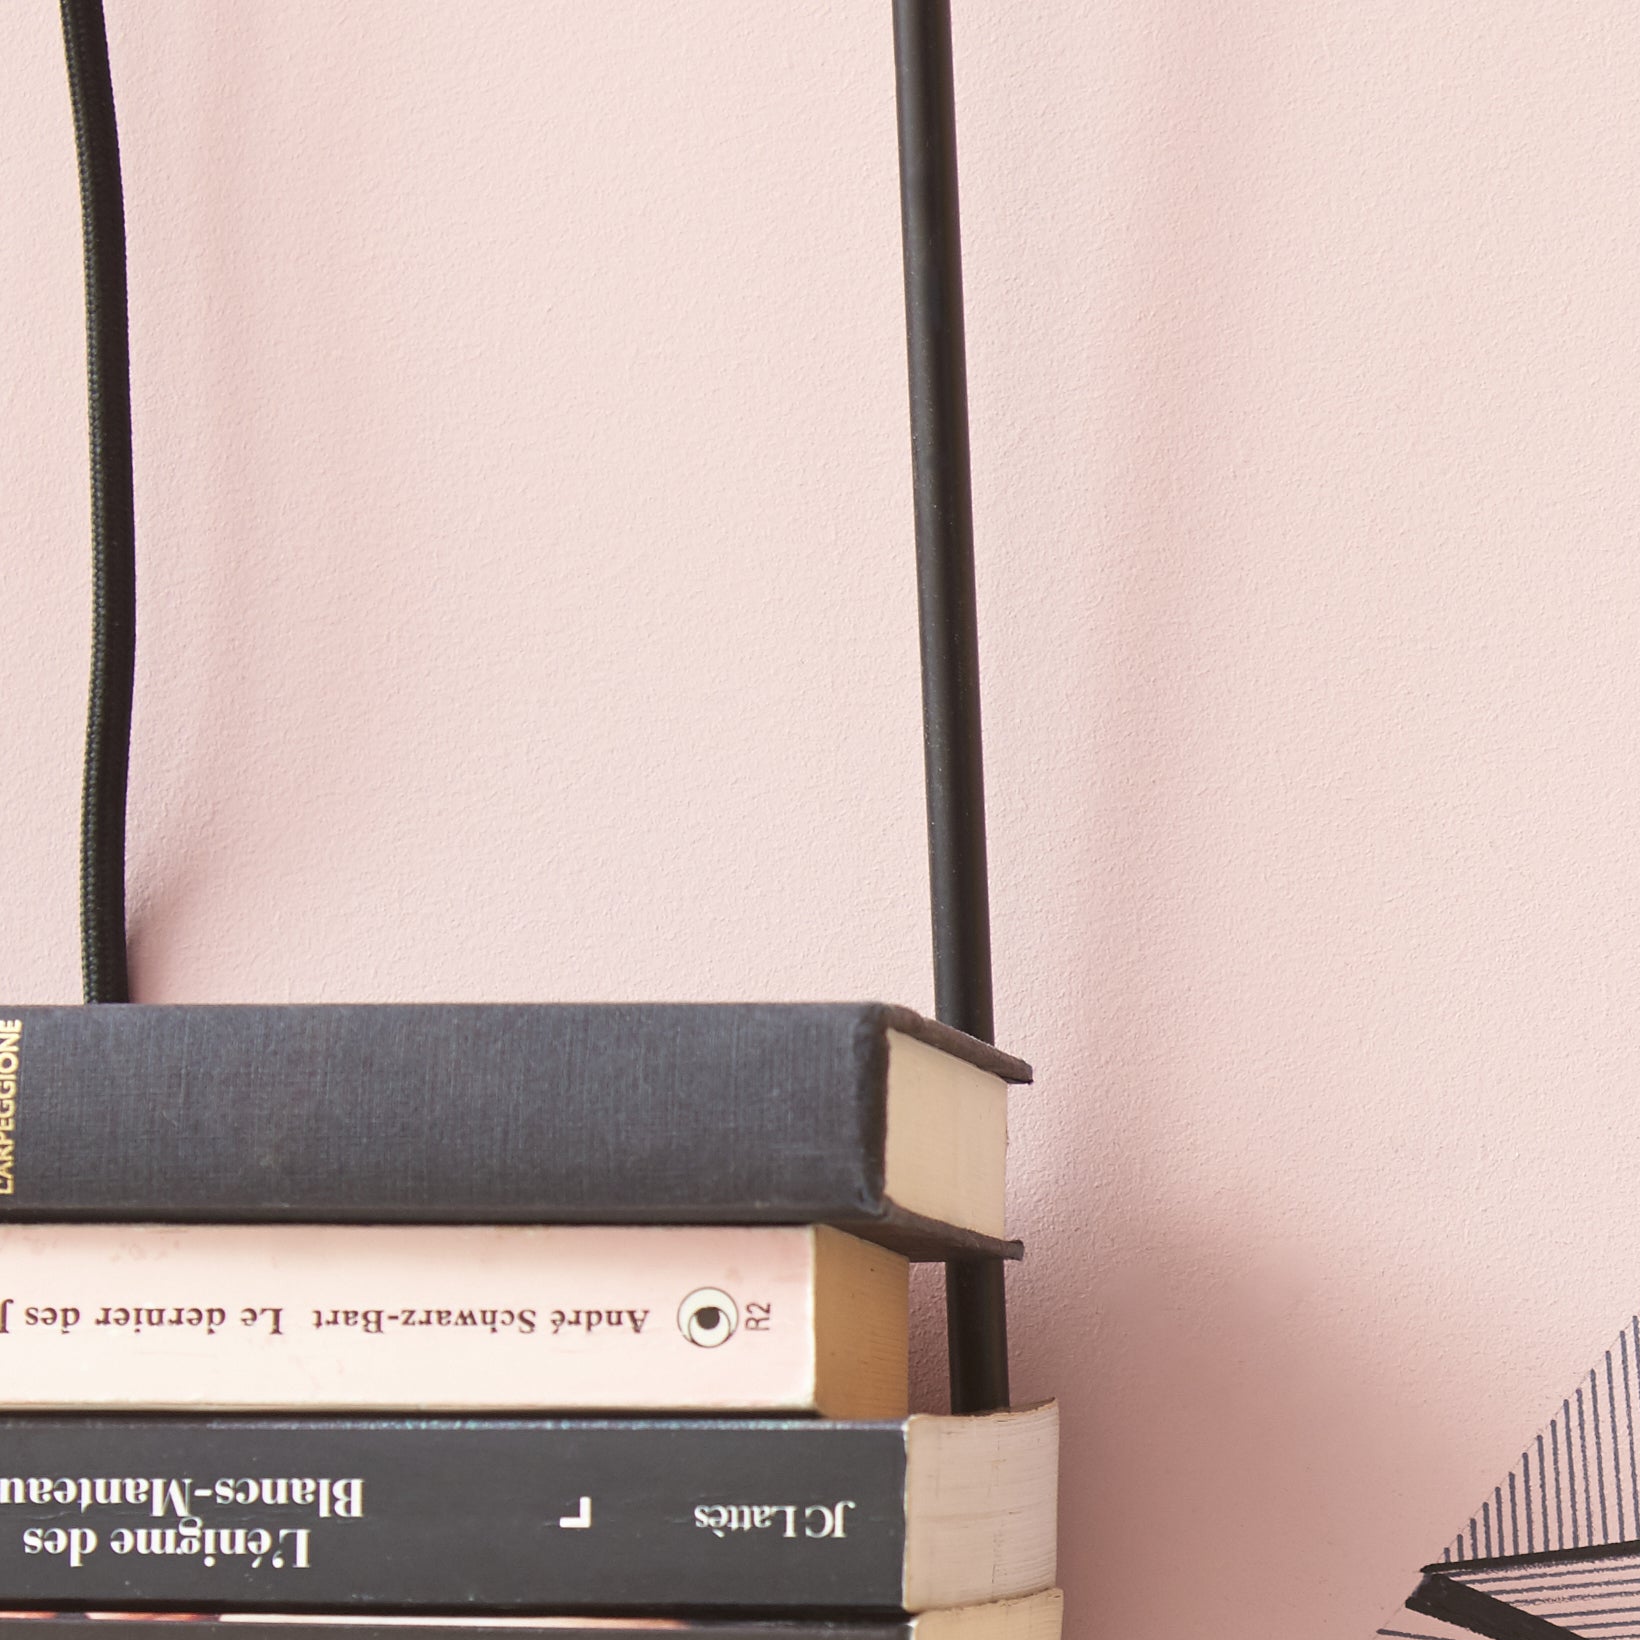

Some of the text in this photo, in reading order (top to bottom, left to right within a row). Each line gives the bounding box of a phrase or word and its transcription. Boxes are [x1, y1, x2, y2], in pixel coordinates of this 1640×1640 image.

[24, 1305, 81, 1335] des
[95, 1305, 227, 1335] dernier
[240, 1306, 284, 1335] Le
[312, 1308, 537, 1334] Schwarz-Bart
[550, 1308, 650, 1334] André
[745, 1302, 771, 1331] R2
[0, 1477, 365, 1518] Blancs-Manteau
[694, 1500, 856, 1538] JC Lattès
[23, 1516, 312, 1569] L'énigme des
